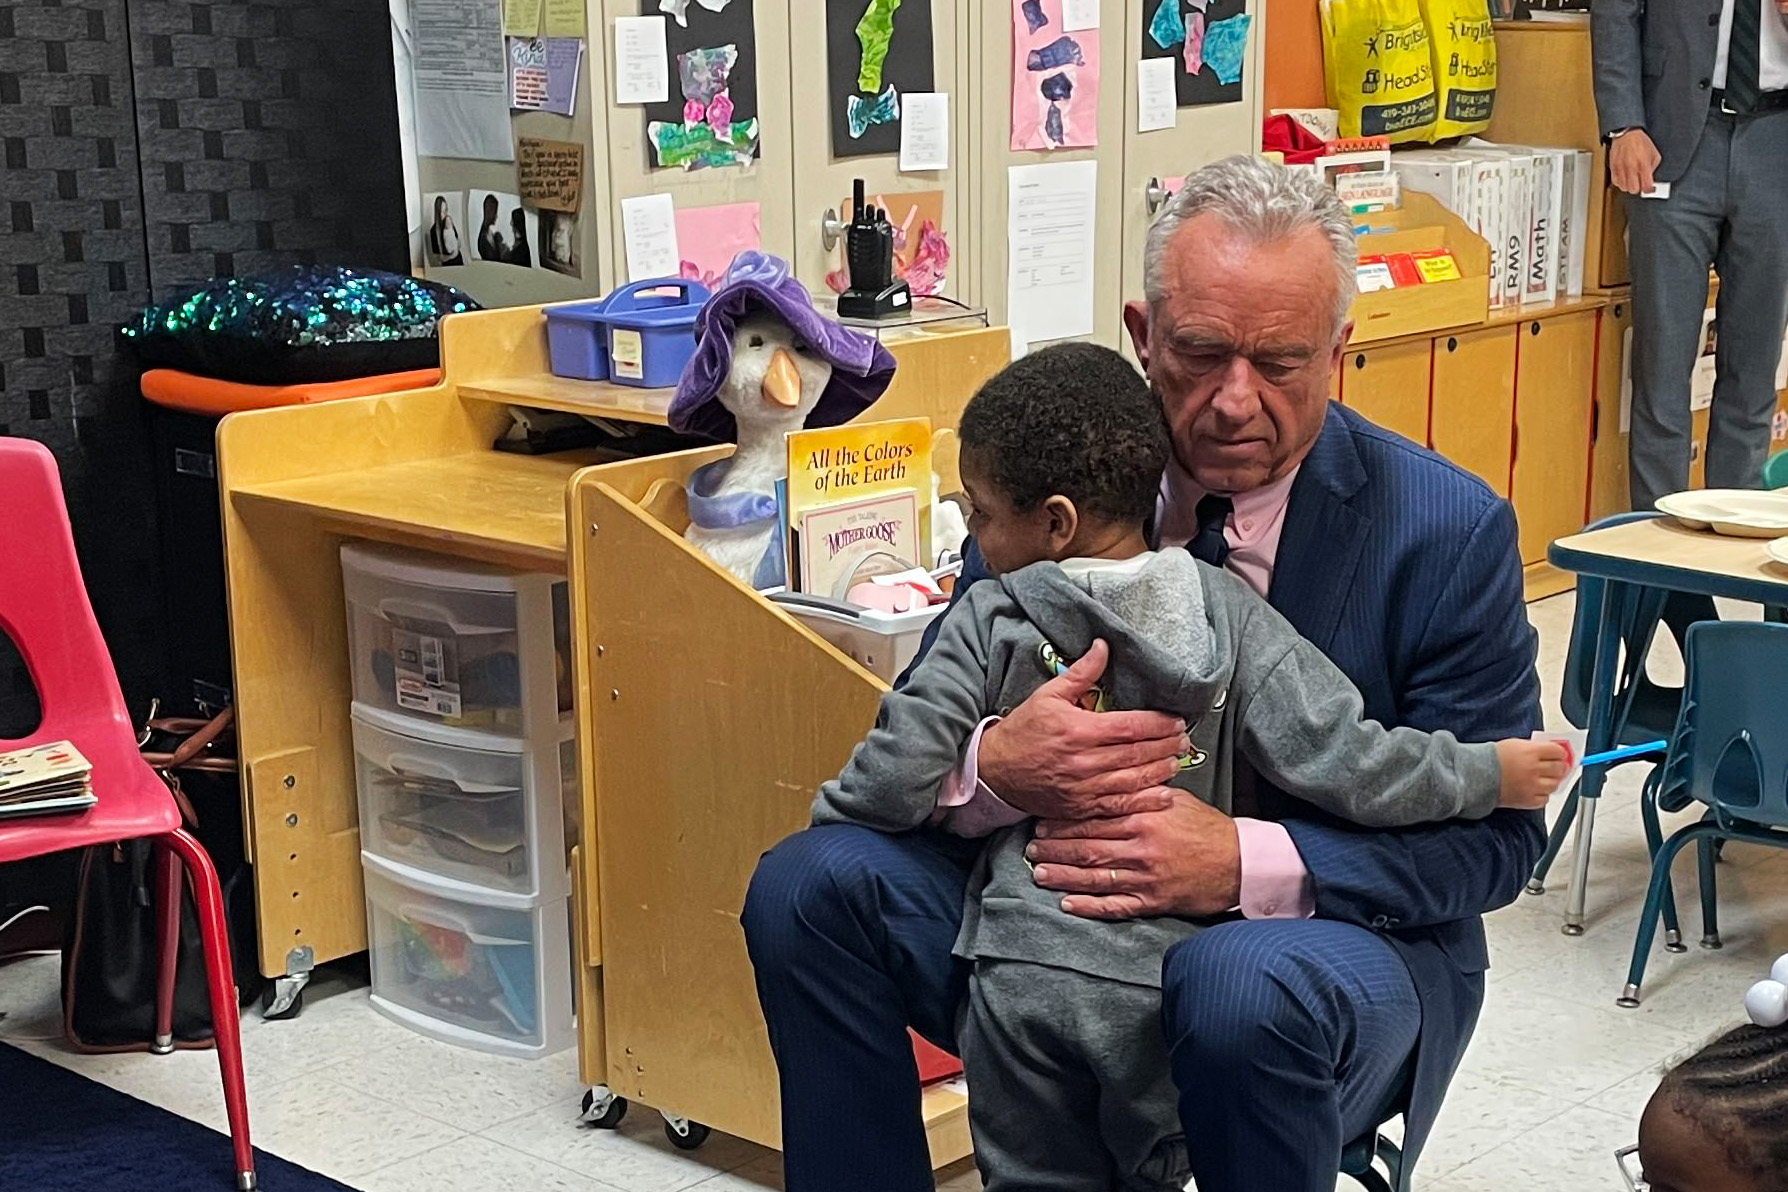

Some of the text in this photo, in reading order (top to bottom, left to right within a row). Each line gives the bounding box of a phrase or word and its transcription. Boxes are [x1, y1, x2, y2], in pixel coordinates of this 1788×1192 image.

[1532, 218, 1546, 280] Math
[806, 440, 914, 471] All the Colors
[815, 460, 906, 493] of the Earth
[828, 521, 897, 560] MOTHER GOOSE
